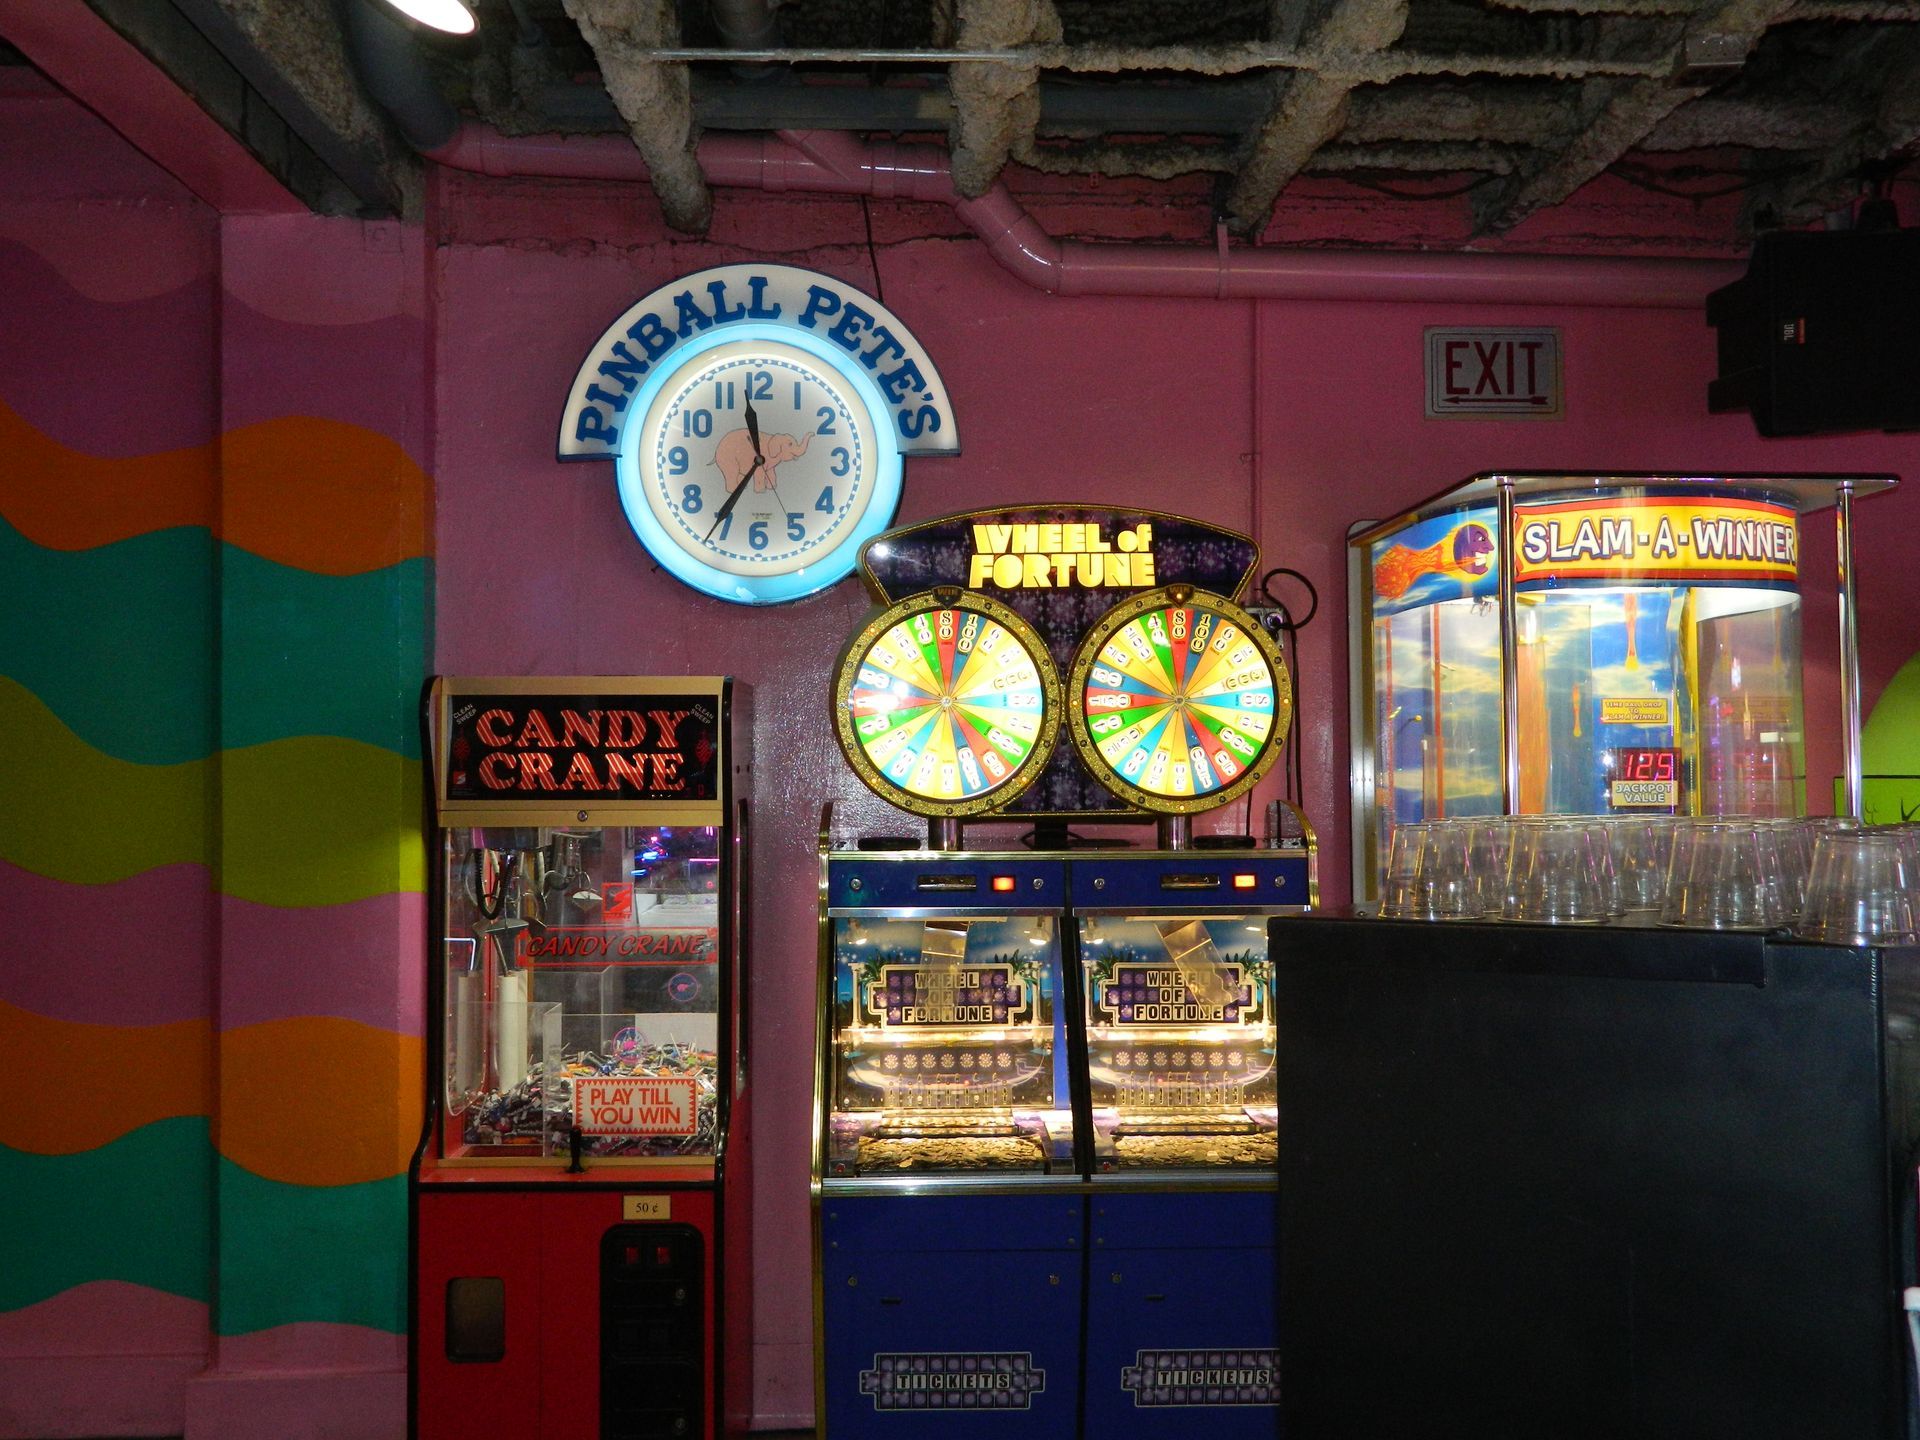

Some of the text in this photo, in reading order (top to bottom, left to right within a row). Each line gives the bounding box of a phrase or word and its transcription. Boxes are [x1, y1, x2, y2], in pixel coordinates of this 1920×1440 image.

[576, 276, 941, 445] PINBALL PETE'S
[1444, 341, 1544, 395] EXIT
[715, 382, 734, 410] 11
[745, 371, 773, 400] 12
[794, 382, 801, 410] 1
[683, 409, 712, 438] 10
[816, 406, 836, 435] 2
[668, 446, 689, 475] 9
[830, 447, 850, 477] 3
[681, 484, 703, 514] 8
[815, 486, 835, 515] 4
[714, 511, 733, 541] 7
[749, 521, 769, 551] 6
[787, 512, 806, 542] 5
[973, 524, 1152, 553] WHEEL of
[969, 553, 1155, 588] FORTUNE
[914, 614, 930, 641] 40
[940, 611, 952, 637] 80
[959, 614, 978, 650] 100
[1173, 610, 1184, 636] 80
[1192, 613, 1211, 650] 100
[981, 626, 1002, 650] 60
[1214, 627, 1234, 650] 60
[1226, 668, 1265, 688] 500
[453, 703, 473, 719] CLEAN
[456, 708, 477, 725] SWEEP
[690, 708, 711, 724] SWEEP
[695, 703, 714, 720] CLEAN
[476, 708, 691, 749] CANDY
[1094, 716, 1120, 733] 40
[1221, 728, 1253, 754] 100
[479, 752, 687, 791] CRANE
[1625, 753, 1673, 779] 125
[1616, 783, 1672, 794] JACKPOT
[1624, 793, 1665, 803] VALUE
[526, 934, 706, 956] CANDY CRANE
[1160, 988, 1185, 1003] OF
[903, 1006, 992, 1022] FORTUNE
[1135, 1005, 1223, 1020] FORTUNE
[590, 1088, 673, 1105] PLAY TILL
[590, 1107, 680, 1125] YOU WIN
[636, 1202, 658, 1213] 50 ¢
[897, 1373, 1010, 1389] TICKETS
[1157, 1370, 1270, 1385] TICKETS
